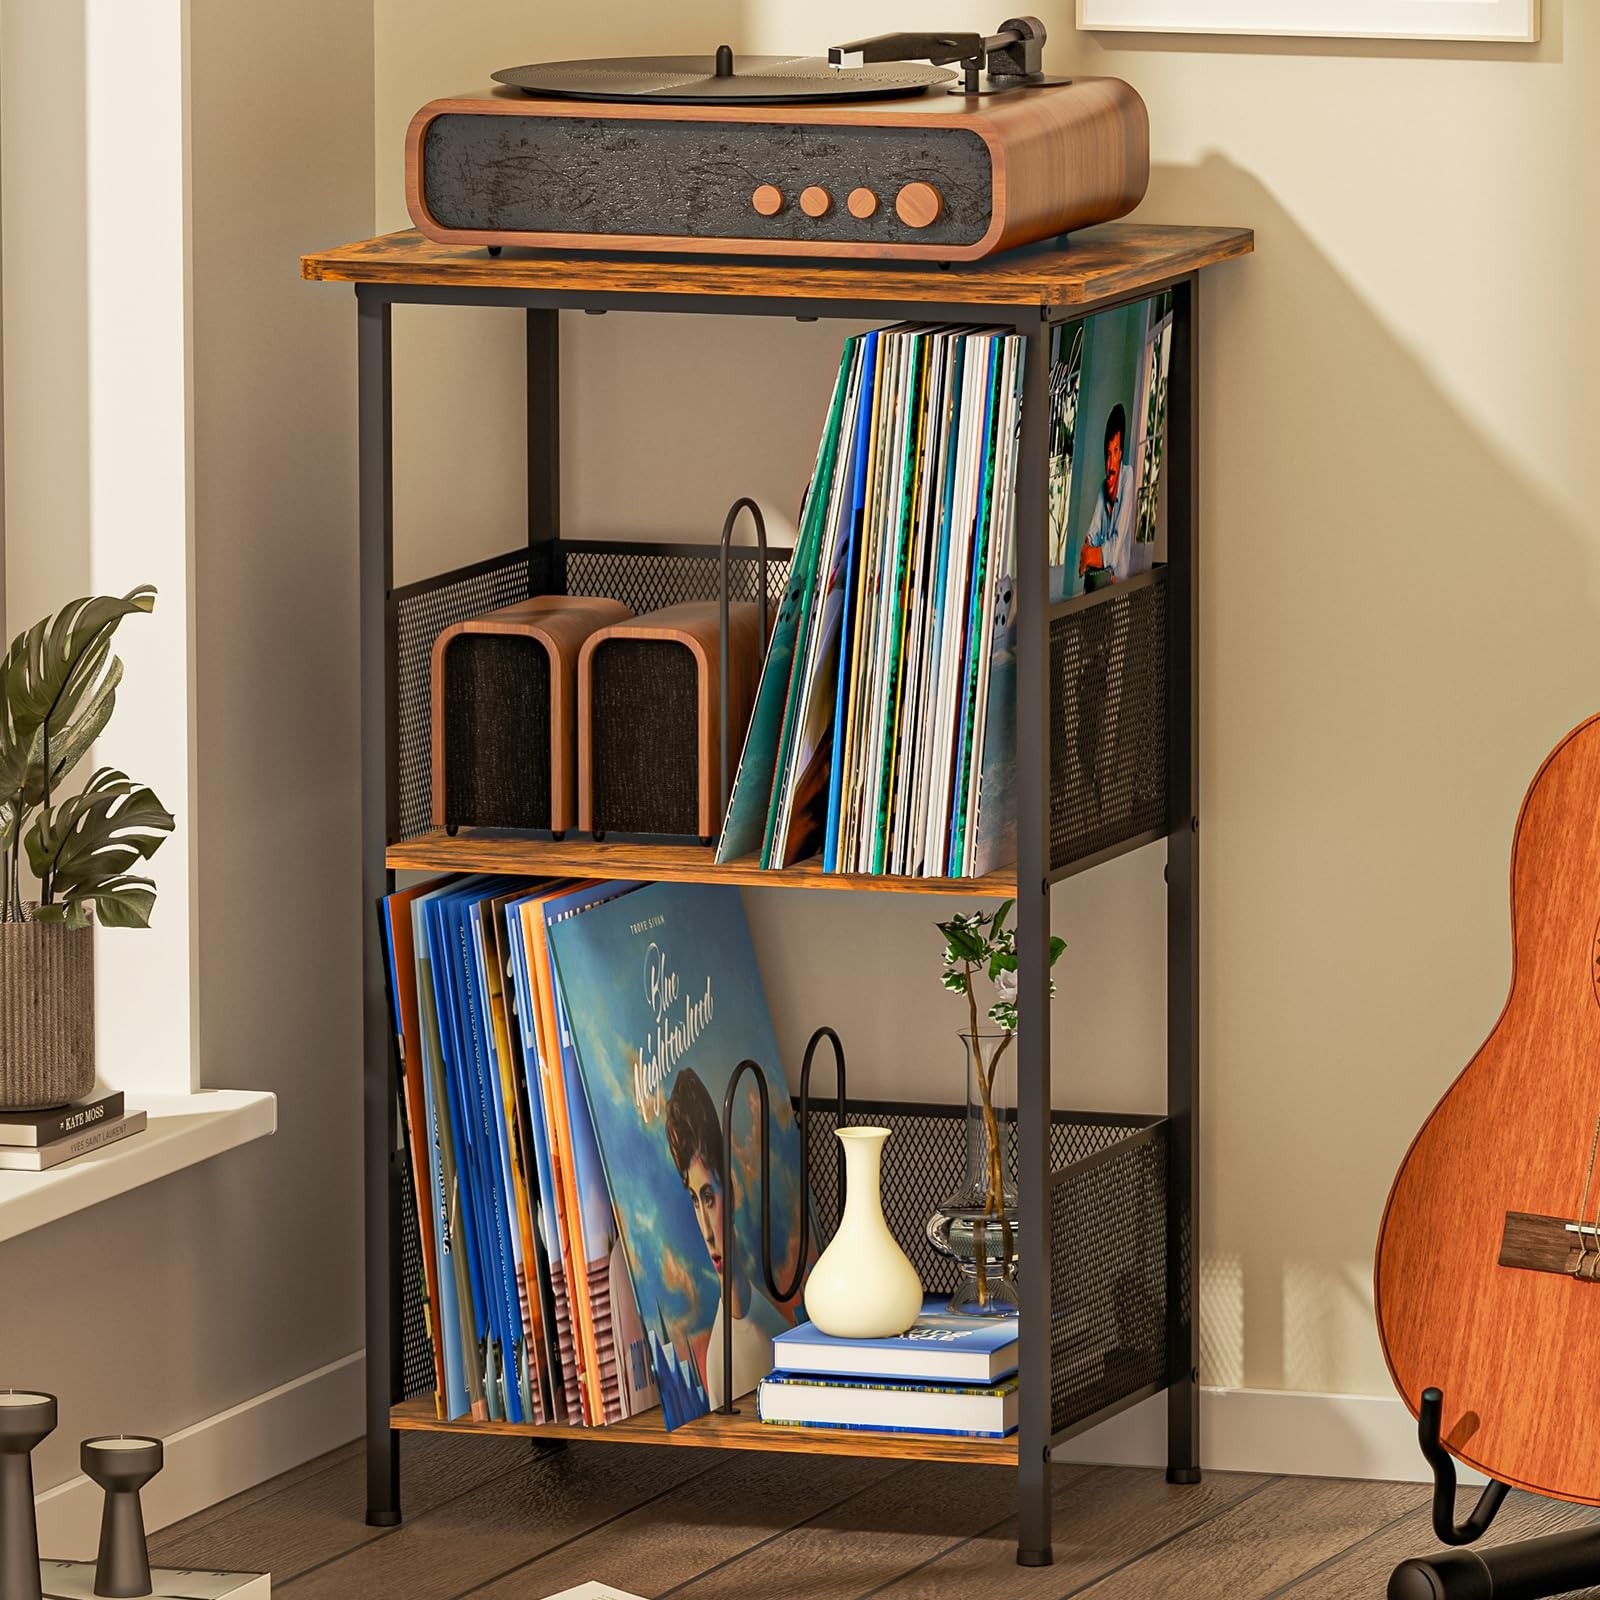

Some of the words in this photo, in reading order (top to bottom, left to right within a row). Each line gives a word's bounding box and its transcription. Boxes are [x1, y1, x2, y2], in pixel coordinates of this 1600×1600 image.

[630, 920, 648, 935] TROYE
[648, 914, 665, 929] SIVAN
[643, 942, 679, 1023] Blue
[634, 976, 714, 1123] Neighbourhood
[65, 1113, 84, 1130] KATE
[85, 1105, 104, 1123] MOSS
[70, 1142, 84, 1153] YVES
[85, 1134, 101, 1148] SAINT
[102, 1124, 127, 1141] LAURENT
[442, 1223, 451, 1256] The
